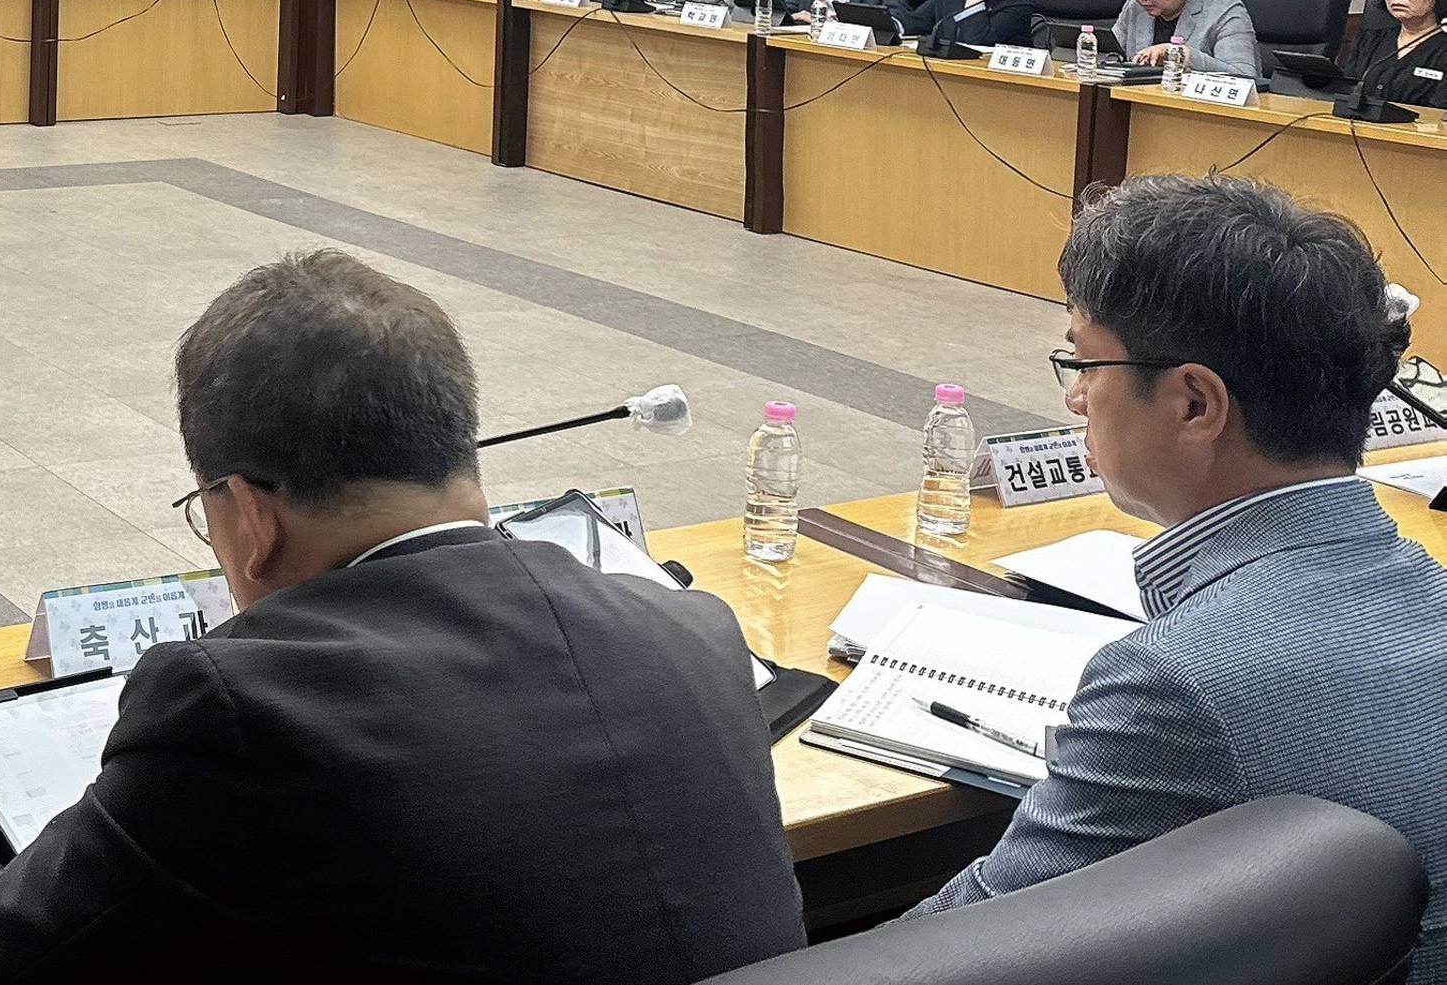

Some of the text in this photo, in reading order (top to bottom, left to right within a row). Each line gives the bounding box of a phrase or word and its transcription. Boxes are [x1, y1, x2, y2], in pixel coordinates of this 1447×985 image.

[998, 56, 1036, 70] 대동면
[1194, 83, 1240, 100] 나산면
[1370, 406, 1438, 437] 림공원
[1005, 455, 1098, 492] 건설교통
[79, 609, 209, 661] 축산과
